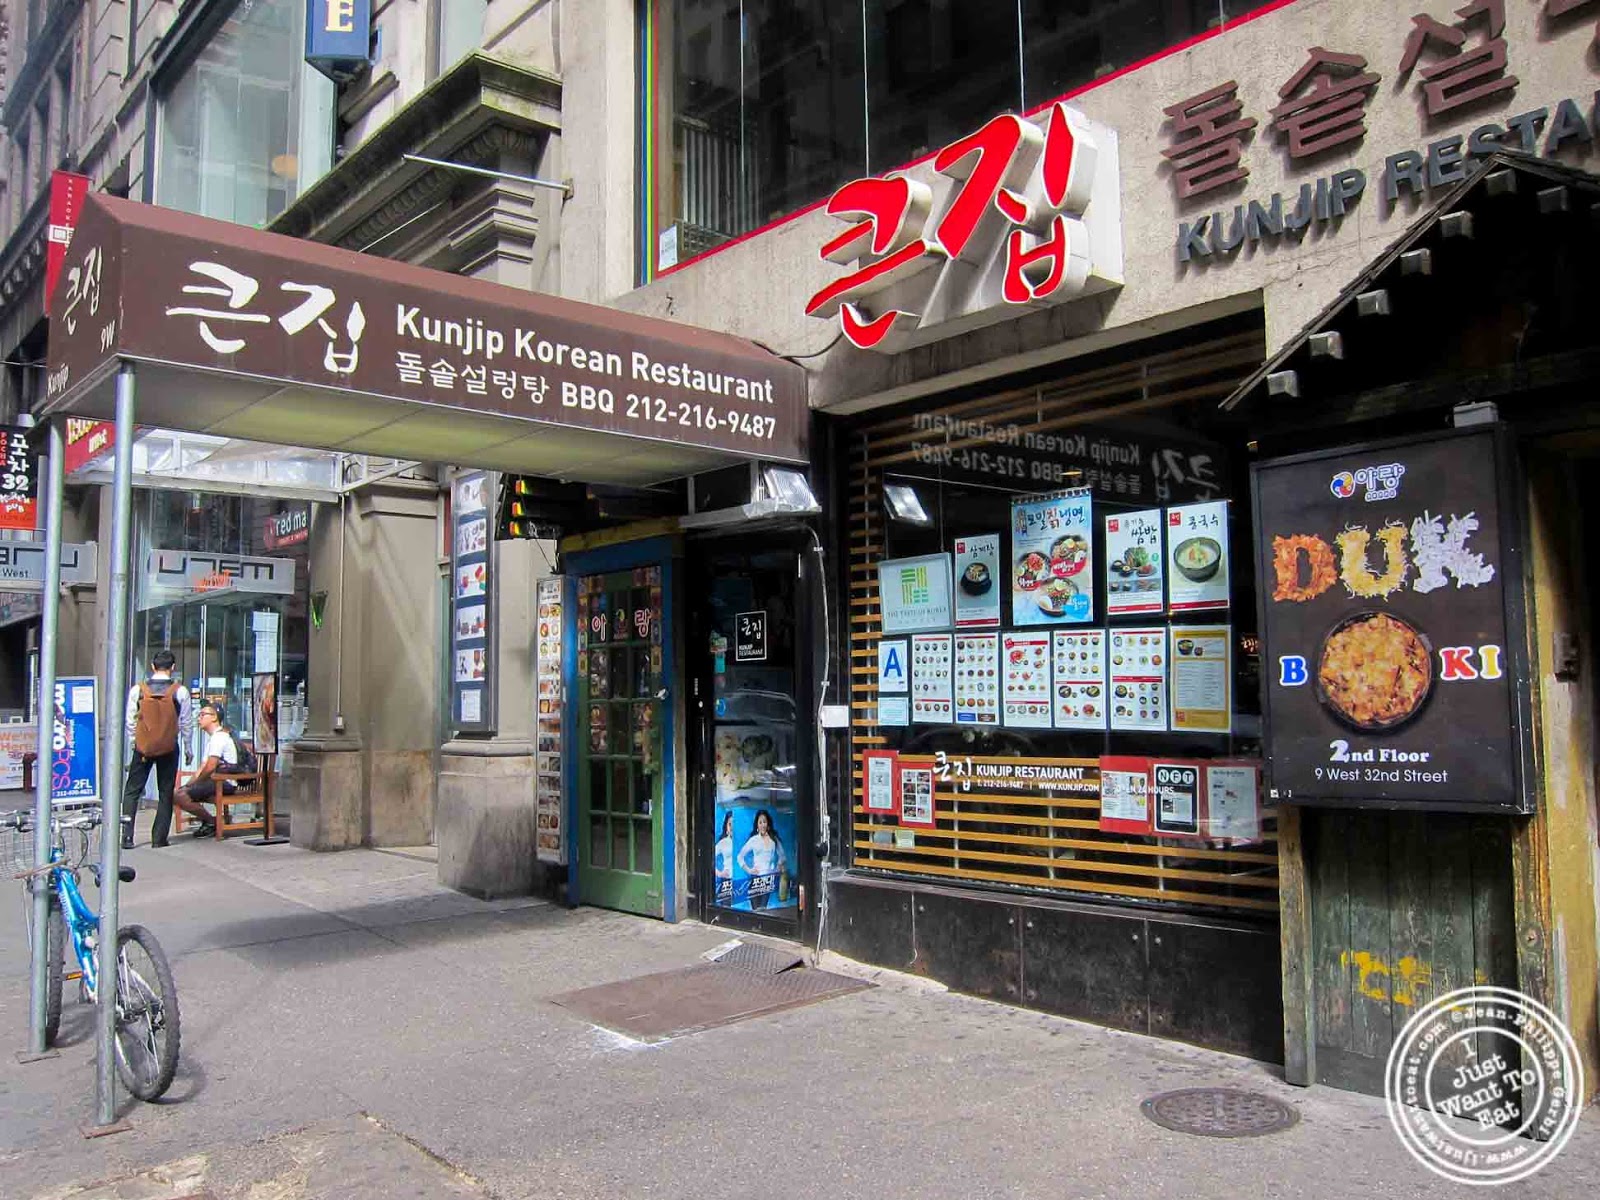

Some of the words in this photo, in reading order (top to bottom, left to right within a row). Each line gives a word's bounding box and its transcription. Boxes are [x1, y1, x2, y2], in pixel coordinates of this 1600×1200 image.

[1177, 168, 1367, 263] KUNJIP
[1384, 90, 1600, 202] RESTA
[804, 101, 1075, 348] 큰집
[165, 261, 366, 374] 큰집
[397, 304, 505, 358] Kunjip
[514, 329, 622, 375] Korean
[631, 352, 773, 403] Restaurant
[396, 351, 549, 405] 돌솥설렁탕
[562, 382, 615, 414] BBQ
[626, 394, 776, 440] 212-216-9487
[2, 473, 29, 491] 32
[1272, 510, 1495, 602] DUK
[3, 568, 29, 578] West
[883, 647, 903, 678] A
[1329, 740, 1374, 763] 2nd
[1379, 749, 1430, 763] Floor
[73, 778, 92, 790] 2FL
[976, 764, 1012, 776] KUNJIP
[1015, 766, 1084, 779] RESTAURANT
[1315, 768, 1323, 780] 9
[1327, 768, 1360, 781] West
[1364, 769, 1399, 782] 32nd
[1403, 769, 1448, 783] Street
[1038, 782, 1099, 792] WWW.KUNJIP.COM
[1148, 786, 1174, 795] HOURS
